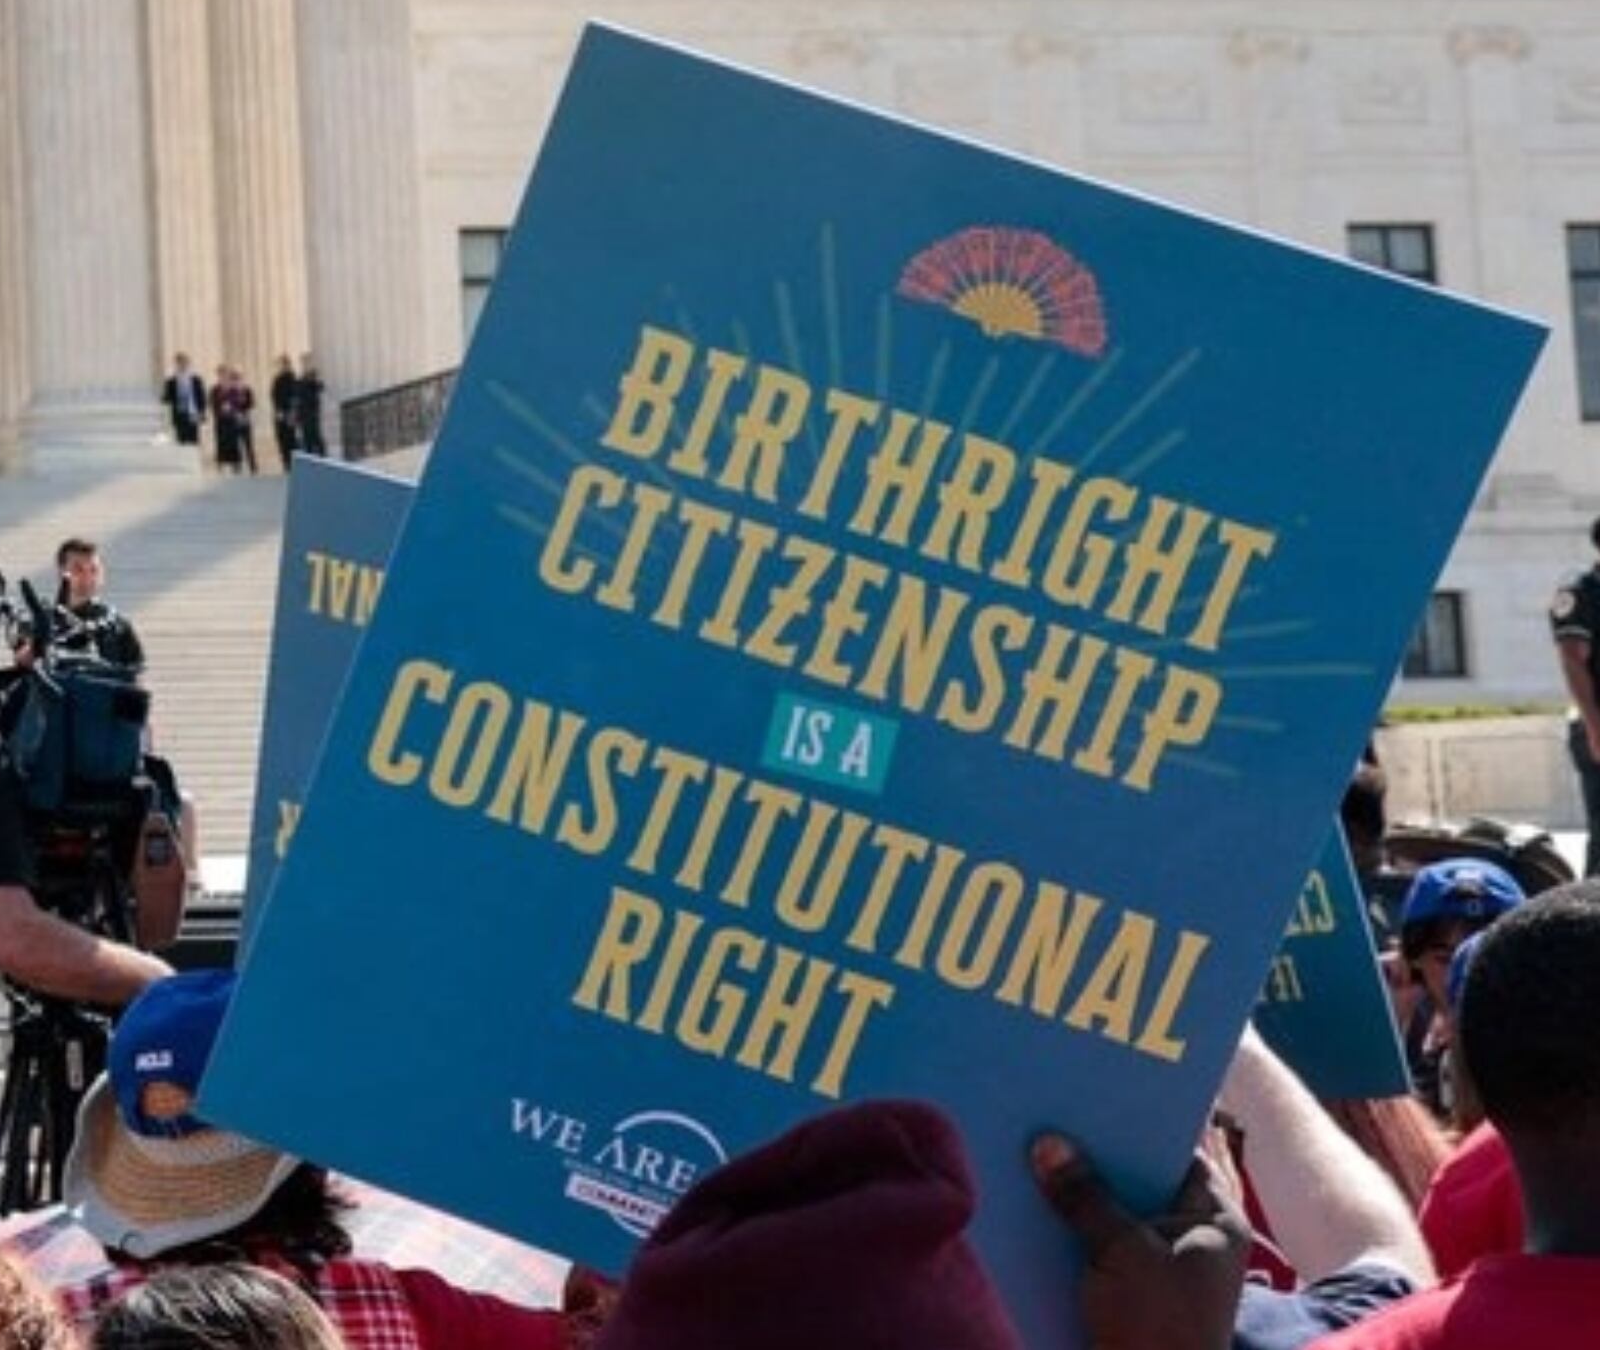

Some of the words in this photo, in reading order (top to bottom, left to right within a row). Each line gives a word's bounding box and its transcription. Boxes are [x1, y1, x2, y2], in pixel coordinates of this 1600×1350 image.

[601, 326, 1276, 650] BIRTHRIGHT
[538, 465, 1224, 792] CITIZENSHIP
[780, 706, 828, 764] IS
[839, 726, 871, 777] A
[368, 660, 1208, 1063] CONSTITUTIONAL
[571, 885, 893, 1099] RIGHT
[511, 1097, 587, 1153] WE
[593, 1136, 697, 1195] ARE
